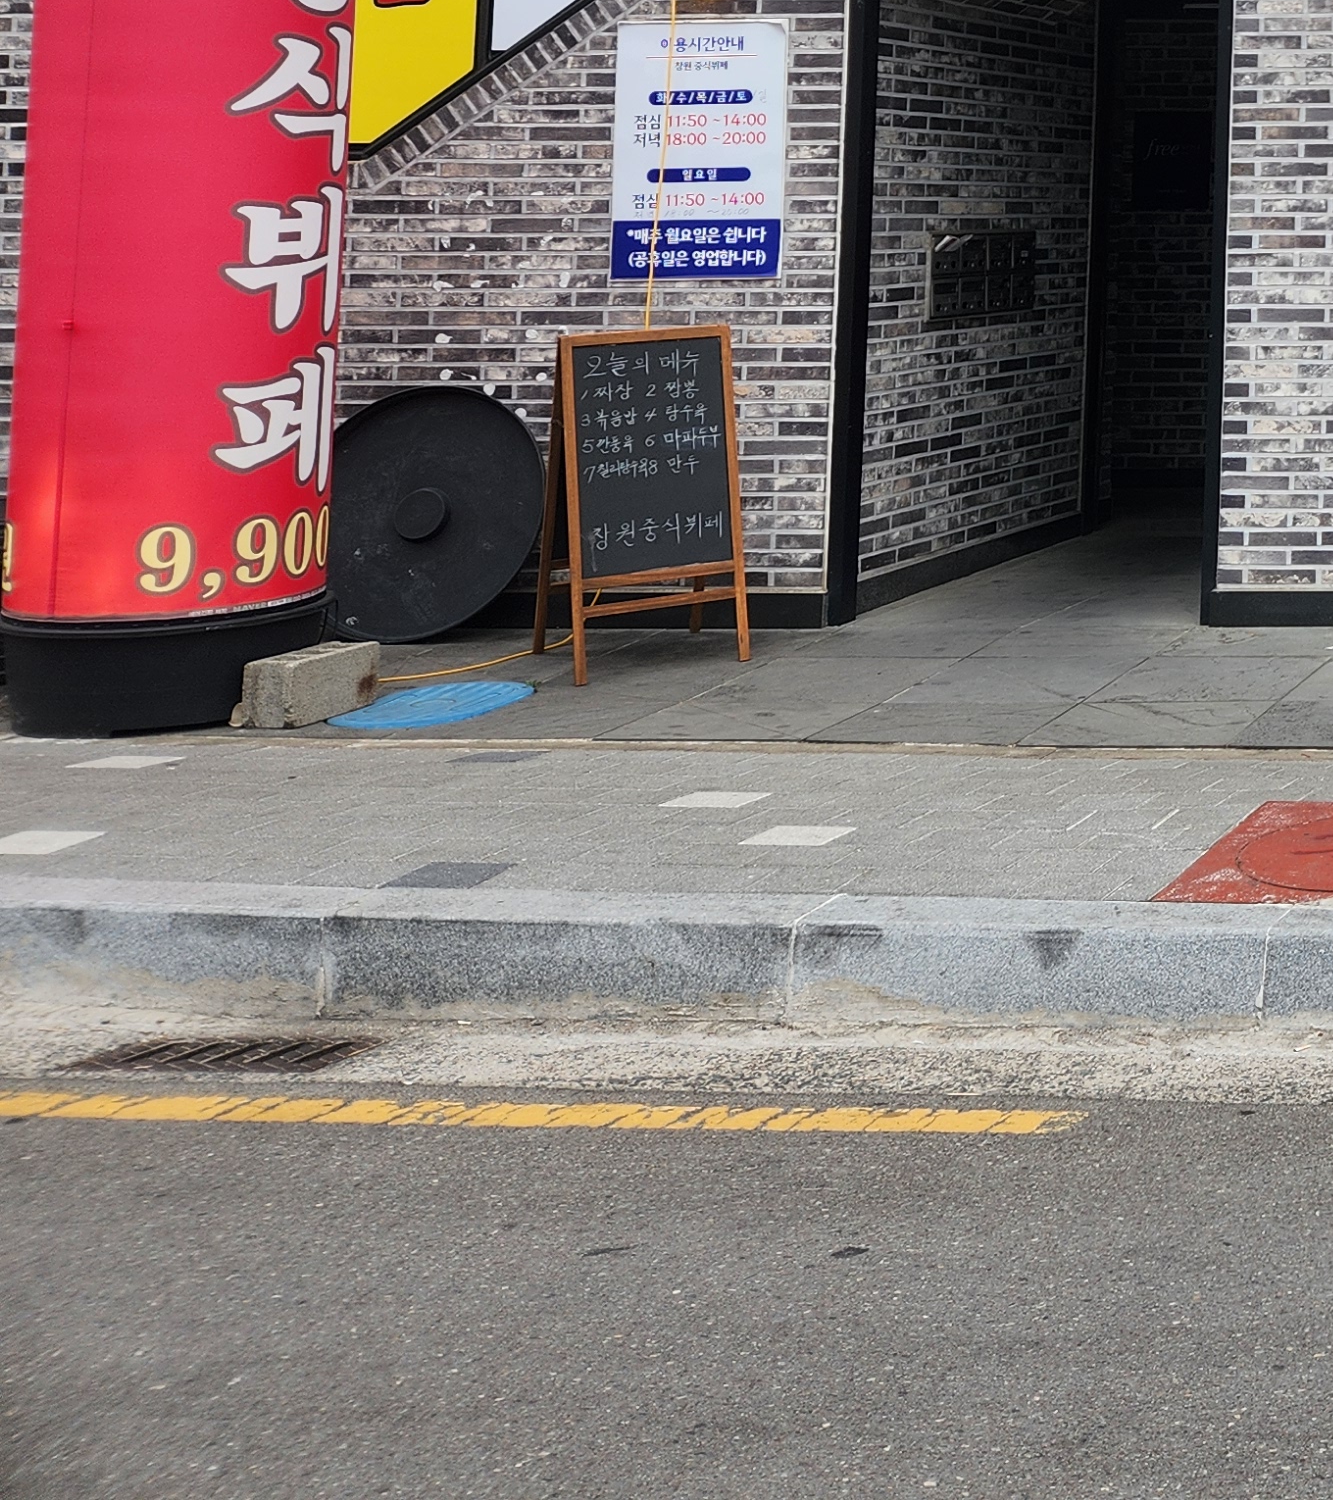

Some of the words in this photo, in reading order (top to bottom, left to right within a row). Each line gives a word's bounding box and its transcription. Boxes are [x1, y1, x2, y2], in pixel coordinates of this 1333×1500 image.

[634, 114, 661, 130] 점심
[667, 114, 707, 127] 11:50
[633, 133, 661, 148] 저녁
[666, 132, 707, 146] 18:00
[632, 193, 659, 209] 점심
[665, 193, 705, 207] 11:50
[664, 227, 721, 244] 월요일은
[723, 226, 767, 243] 쉽니다
[692, 249, 767, 267] 영업합니다)
[659, 349, 700, 377] 메뉴
[646, 384, 657, 397] 2
[580, 413, 591, 427] 3
[644, 407, 658, 422] 4
[581, 439, 594, 454] 5
[645, 434, 656, 447] 6
[667, 454, 700, 475] 만두
